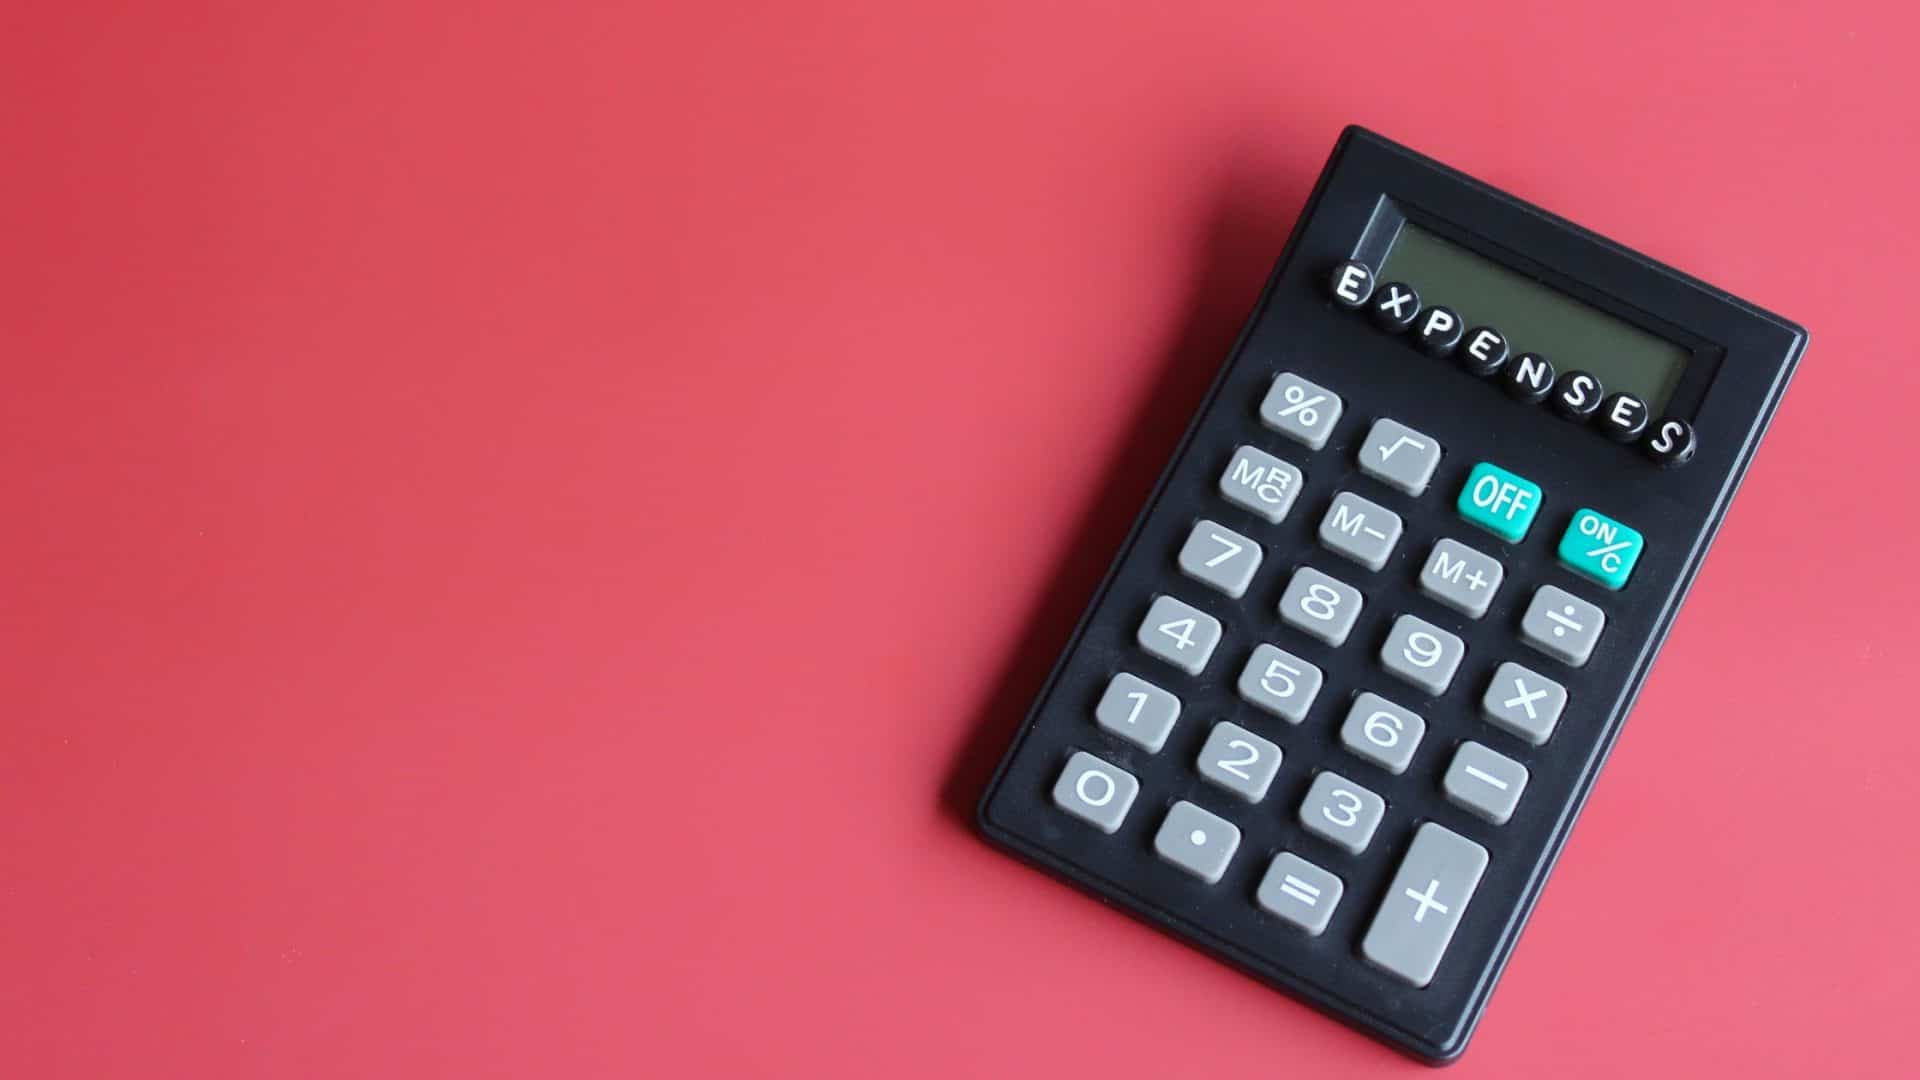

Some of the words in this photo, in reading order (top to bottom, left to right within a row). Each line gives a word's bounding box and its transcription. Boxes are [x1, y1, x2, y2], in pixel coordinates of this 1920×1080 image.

[1335, 265, 1684, 454] EXPENSES
[1277, 385, 1329, 427] %
[1472, 475, 1533, 520] OFF
[1205, 533, 1243, 568] 7
[1432, 551, 1489, 591] M+
[1300, 583, 1341, 620] 8
[1158, 618, 1196, 650] 4
[1403, 631, 1444, 668] 9
[1260, 659, 1301, 698] 5
[1125, 691, 1149, 724] 1
[1363, 711, 1404, 748] 6
[1216, 739, 1261, 780] 2
[1322, 789, 1363, 827] 3
[1279, 873, 1321, 907] =
[1405, 879, 1449, 923] +
